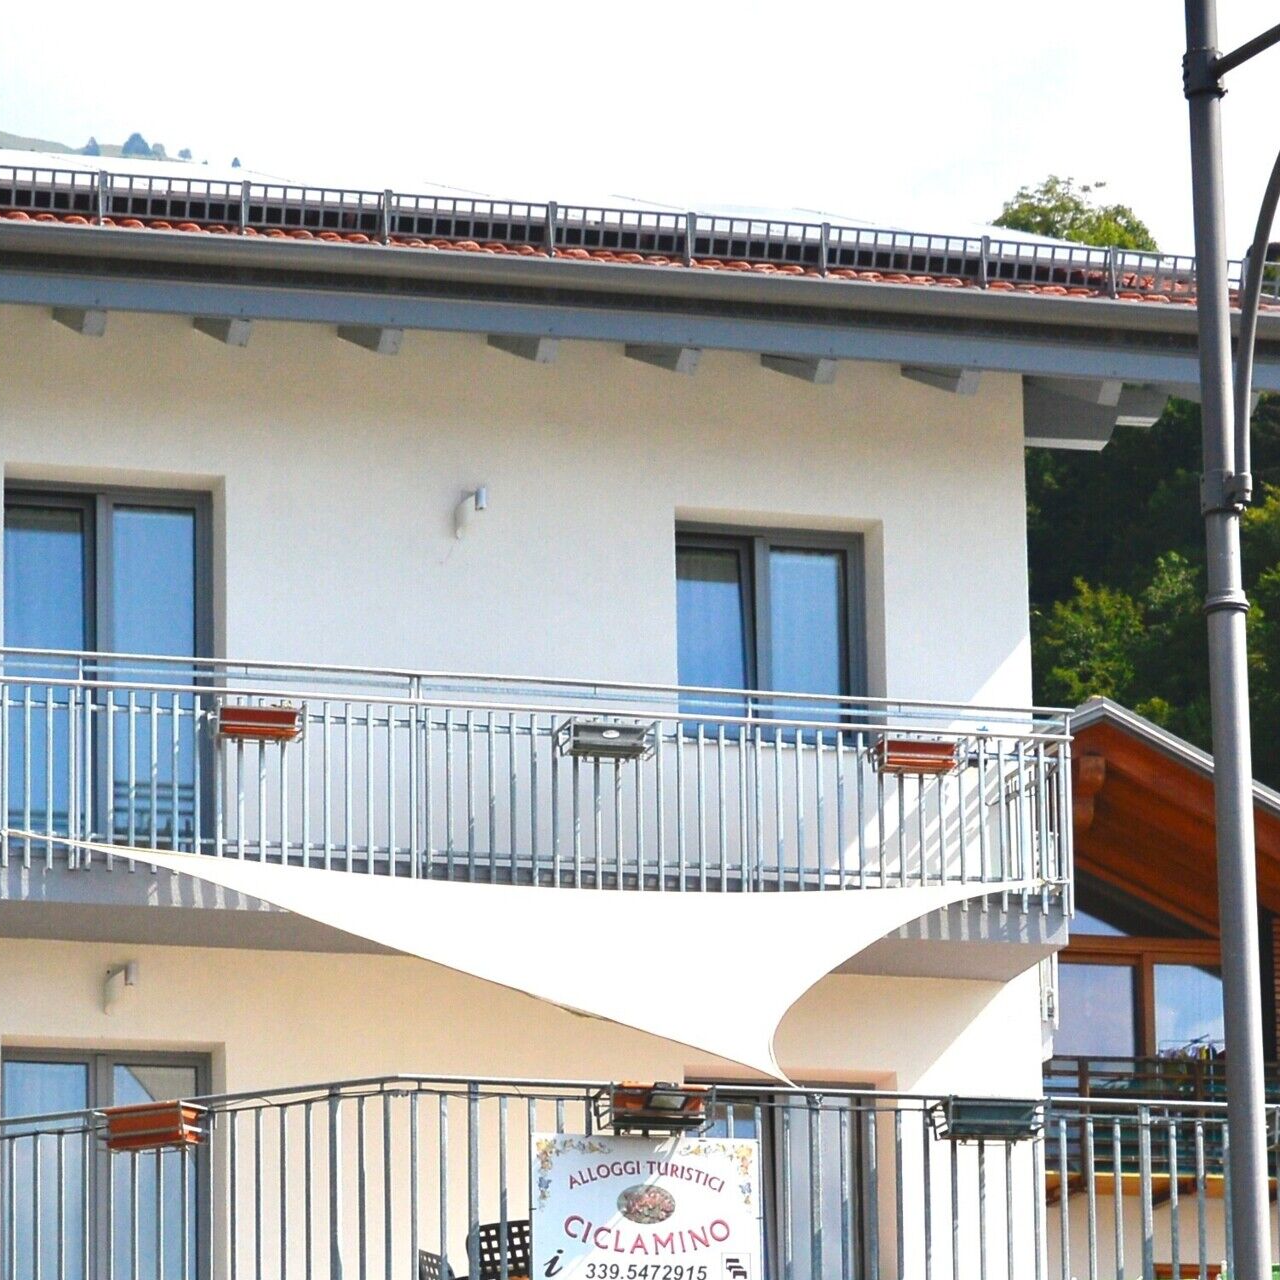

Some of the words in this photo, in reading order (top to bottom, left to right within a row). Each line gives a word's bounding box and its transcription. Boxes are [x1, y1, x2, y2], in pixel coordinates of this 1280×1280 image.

[569, 1160, 641, 1190] ALLOGGI
[646, 1160, 726, 1193] TURISTICI
[563, 1214, 731, 1256] CICLAMINO
